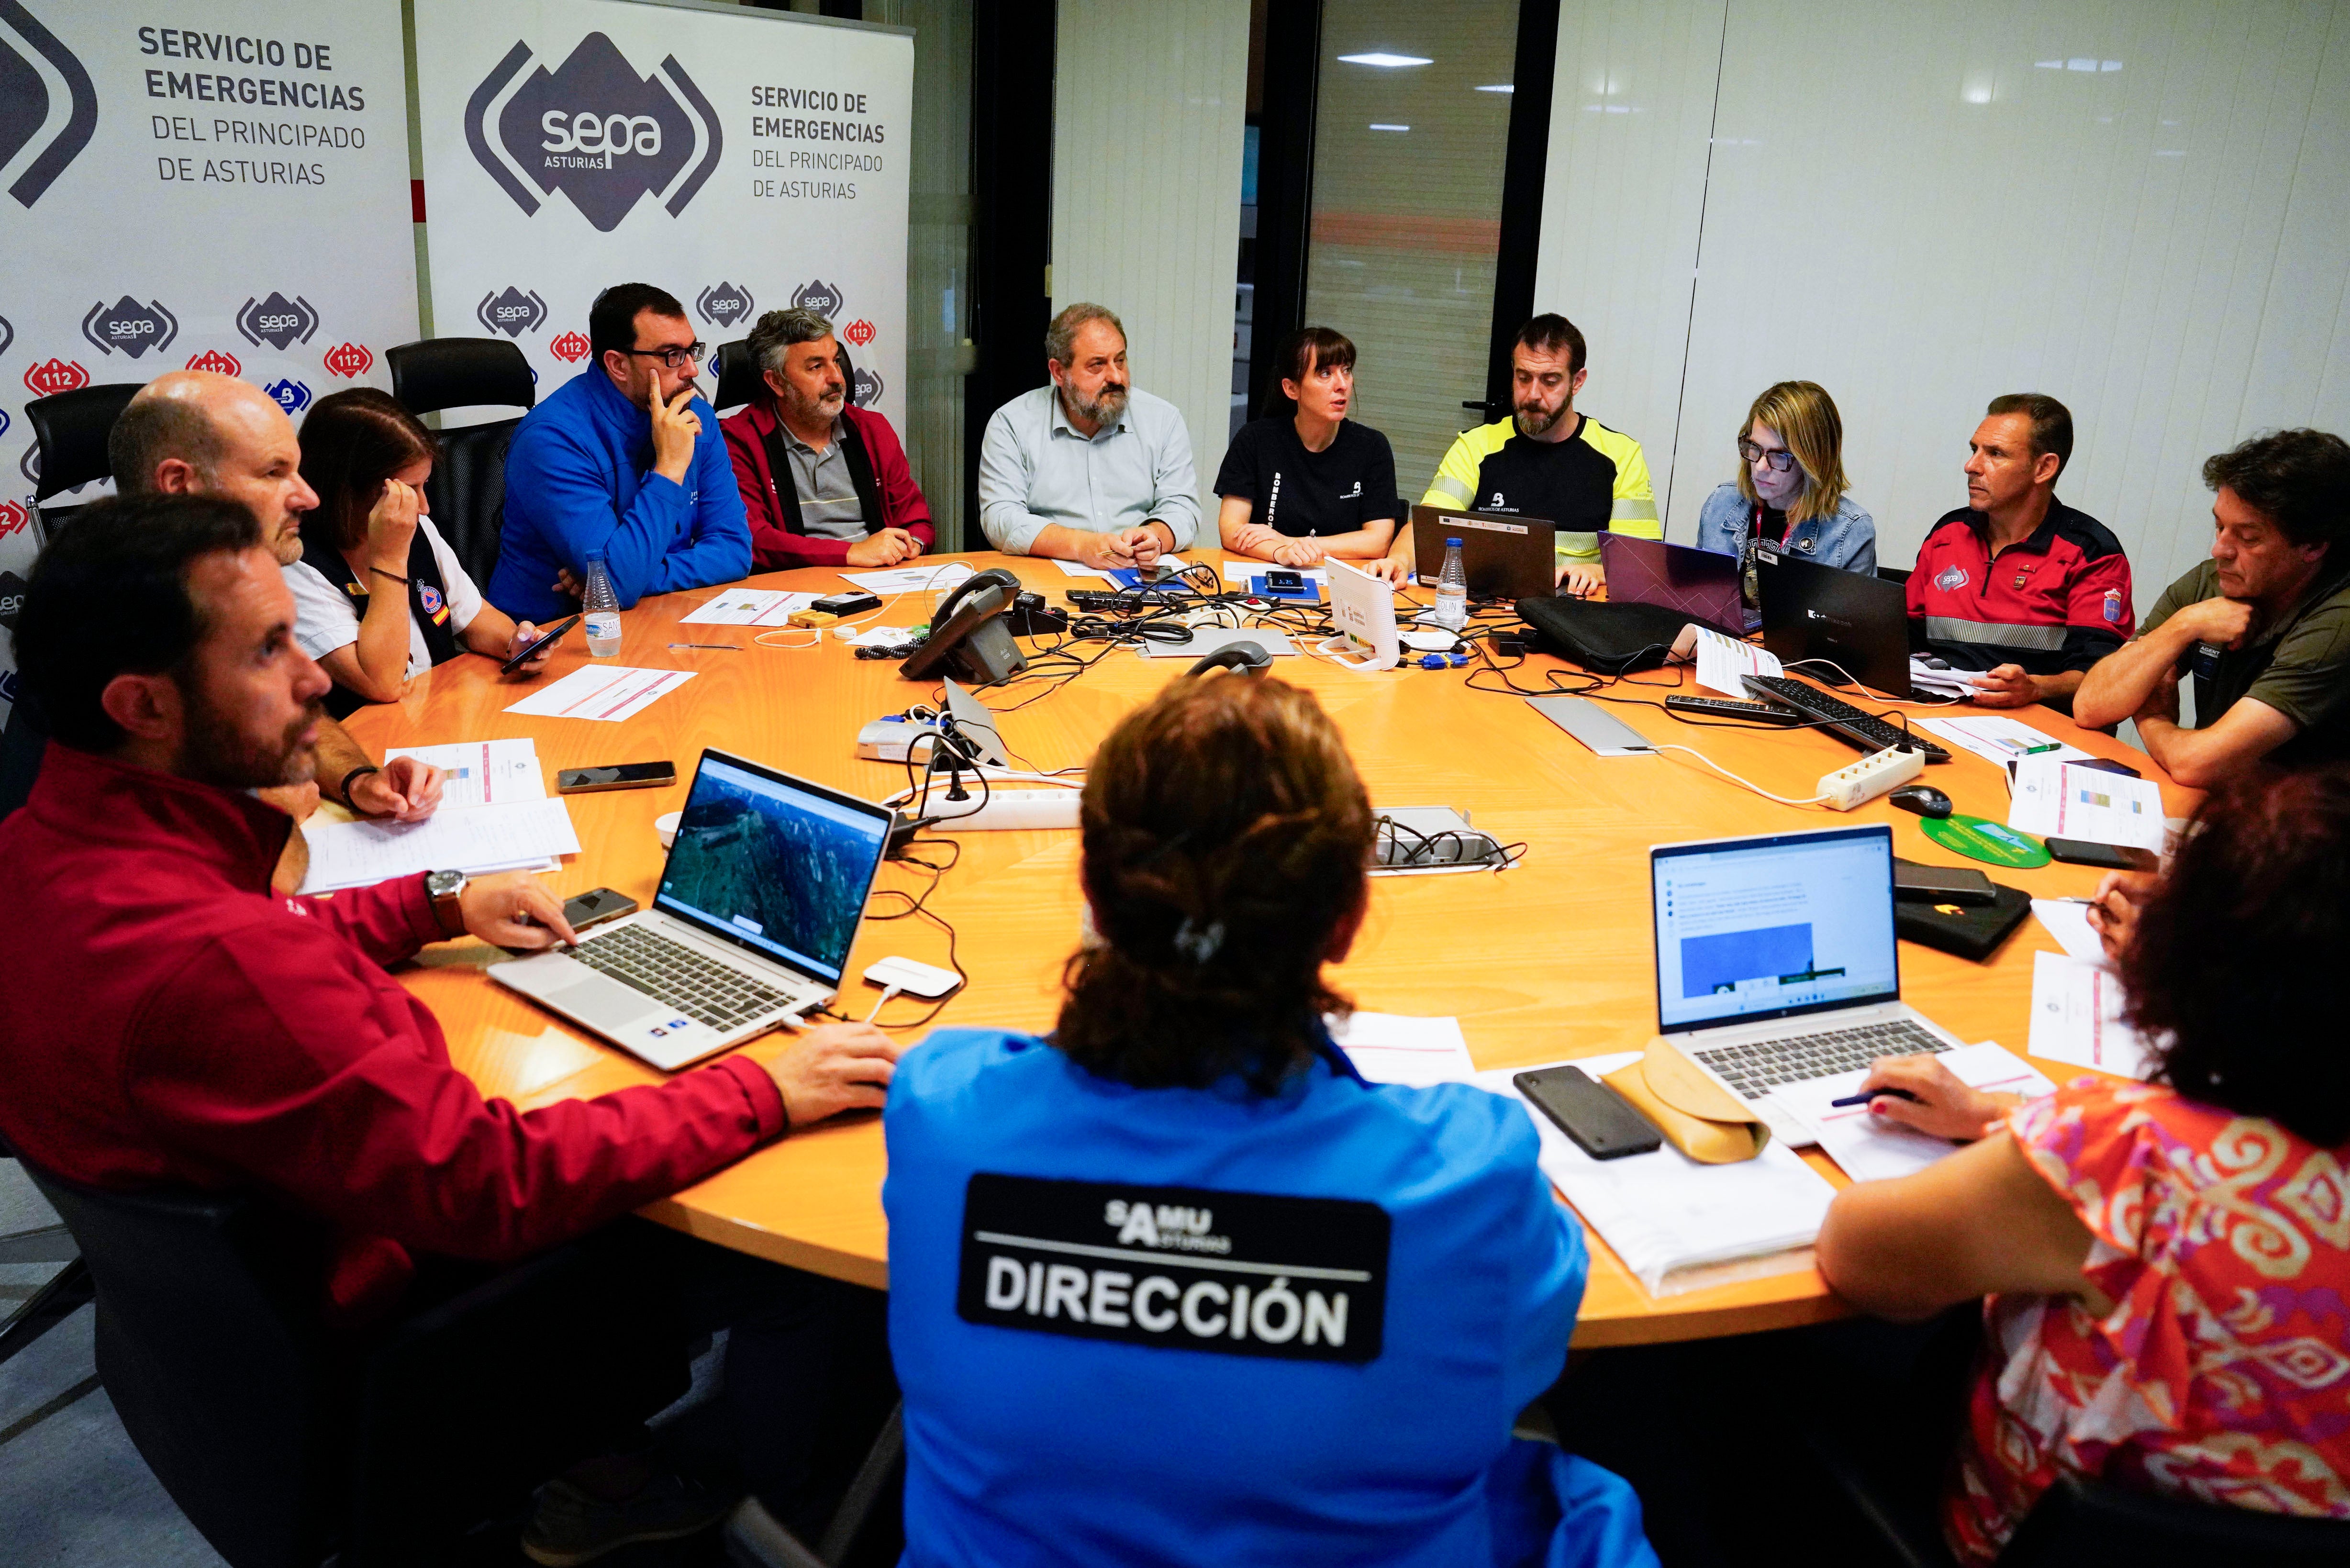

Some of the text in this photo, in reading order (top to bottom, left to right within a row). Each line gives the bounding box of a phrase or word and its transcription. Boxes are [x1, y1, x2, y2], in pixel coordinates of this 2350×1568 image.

[138, 26, 332, 71] SERVICIO DE
[145, 69, 365, 111] EMERGENCIAS
[751, 86, 867, 113] SERVICIO DE
[152, 116, 365, 149] DEL PRINCIPADO
[541, 110, 661, 169] sepa
[753, 117, 884, 144] EMERGENCIAS
[545, 156, 604, 169] ASTURIAS
[754, 150, 883, 171] DEL PRINCIPADO
[158, 157, 325, 185] DE ASTURIAS
[754, 180, 856, 199] DE ASTURIAS
[712, 299, 740, 313] sepa
[804, 296, 830, 311] sepa
[496, 306, 530, 321] sepa
[109, 320, 155, 339] sepa
[259, 314, 299, 332] sepa
[853, 328, 868, 338] 112
[562, 342, 581, 353] 112
[201, 363, 226, 375] 112
[338, 354, 360, 367] 112
[43, 372, 72, 386] 112
[281, 388, 294, 404] B
[855, 383, 872, 397] epa
[1268, 472, 1281, 528] BOMBEROS
[1943, 575, 1958, 584] sepa
[0, 594, 25, 613] ep
[1437, 600, 1457, 611] TOLIN
[1104, 1199, 1213, 1245] SAMU
[985, 1256, 1350, 1347] DIRECCIÓN
